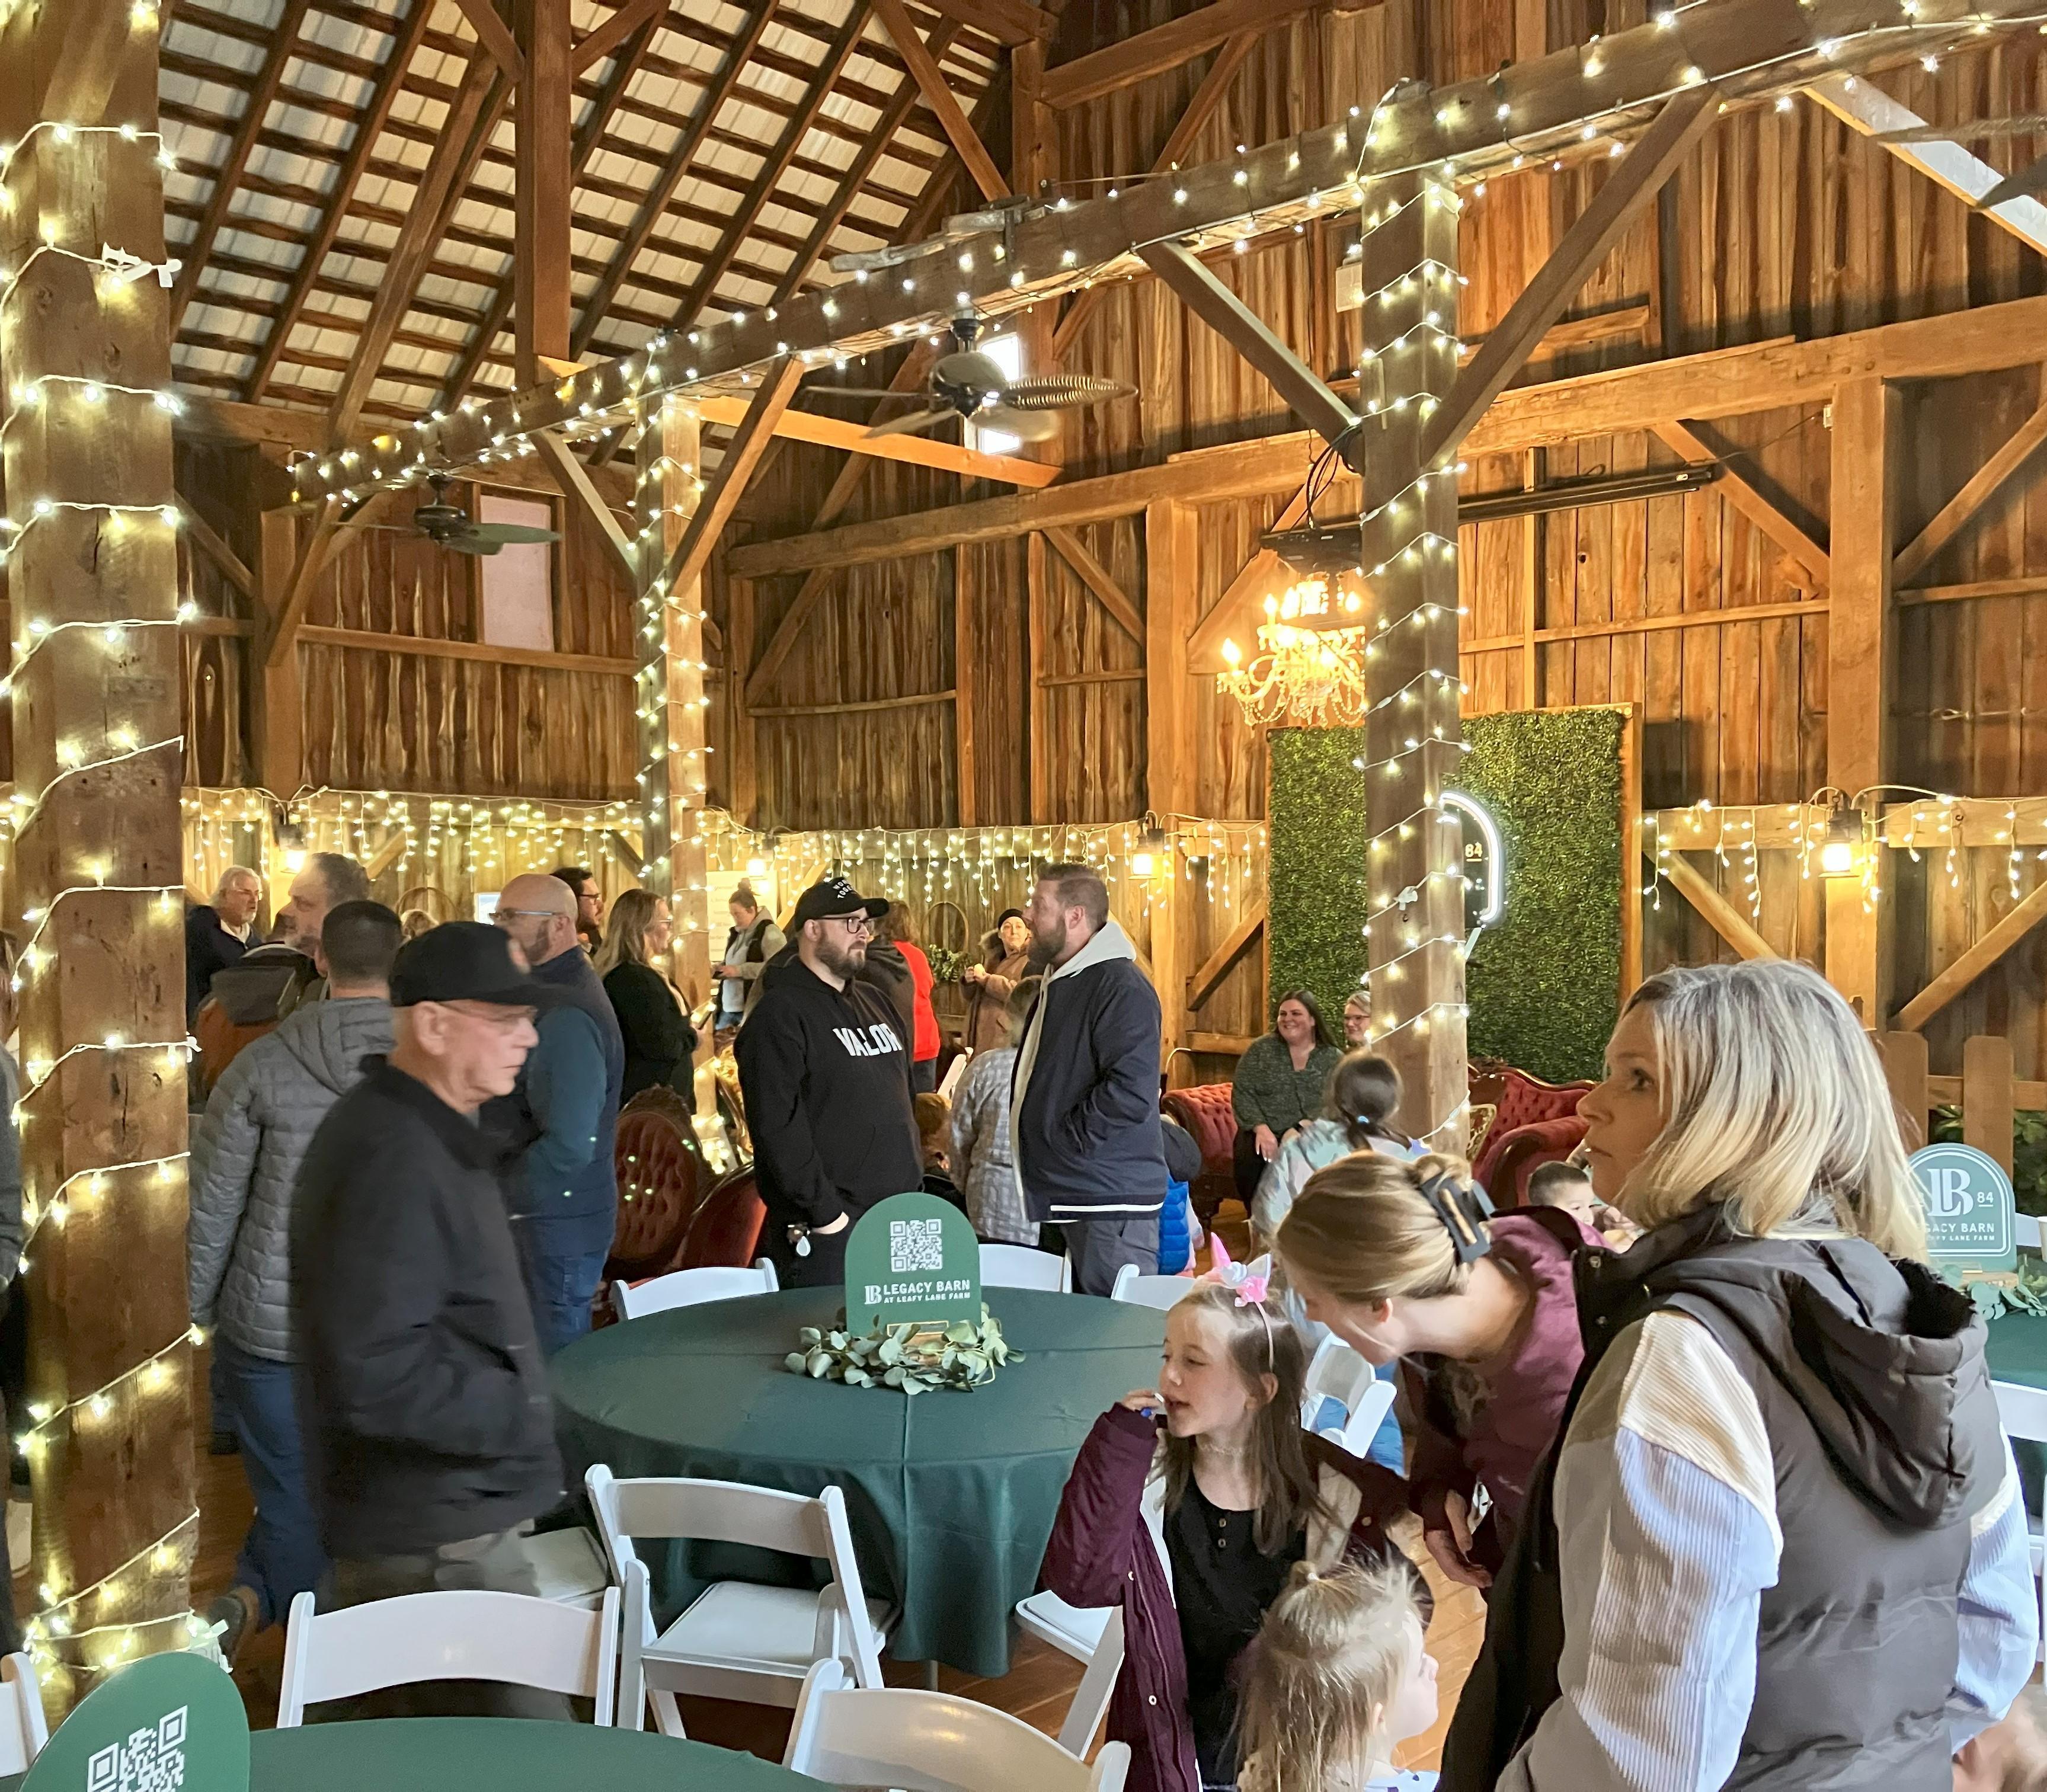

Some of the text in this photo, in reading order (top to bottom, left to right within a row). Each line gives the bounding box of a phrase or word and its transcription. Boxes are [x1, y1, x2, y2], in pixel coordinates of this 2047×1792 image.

[1465, 843, 1482, 857] 84
[832, 1023, 902, 1057] VALOR
[1977, 1191, 1994, 1204] 84
[1926, 1223, 1994, 1233] GACY BARN
[883, 1279, 970, 1295] LEGACY BARN
